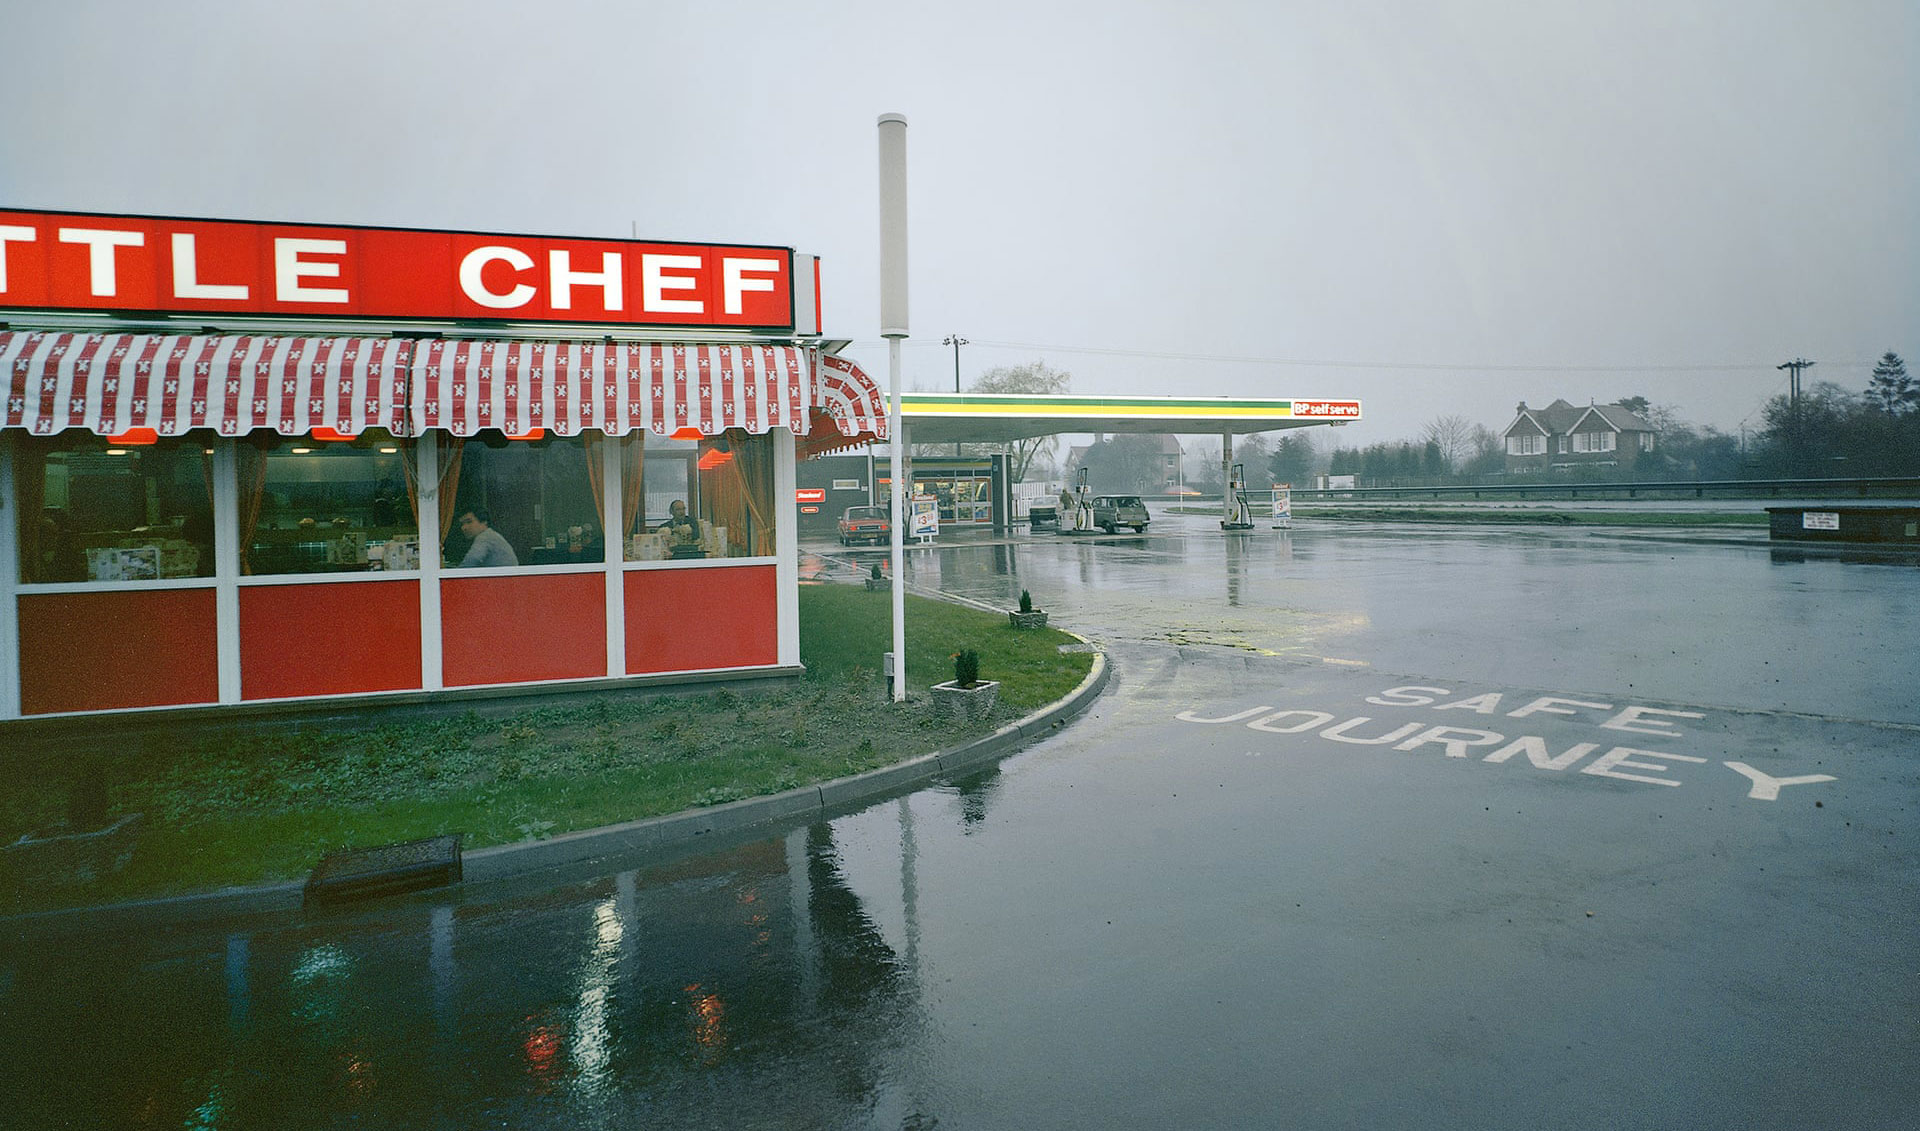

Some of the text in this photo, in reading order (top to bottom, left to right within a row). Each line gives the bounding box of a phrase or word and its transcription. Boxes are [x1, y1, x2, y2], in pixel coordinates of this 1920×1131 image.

[458, 245, 781, 315] CHEF
[1295, 403, 1358, 415] BP self serve
[1365, 686, 1706, 738] SAFE
[1175, 705, 1839, 801] JOURNEY
